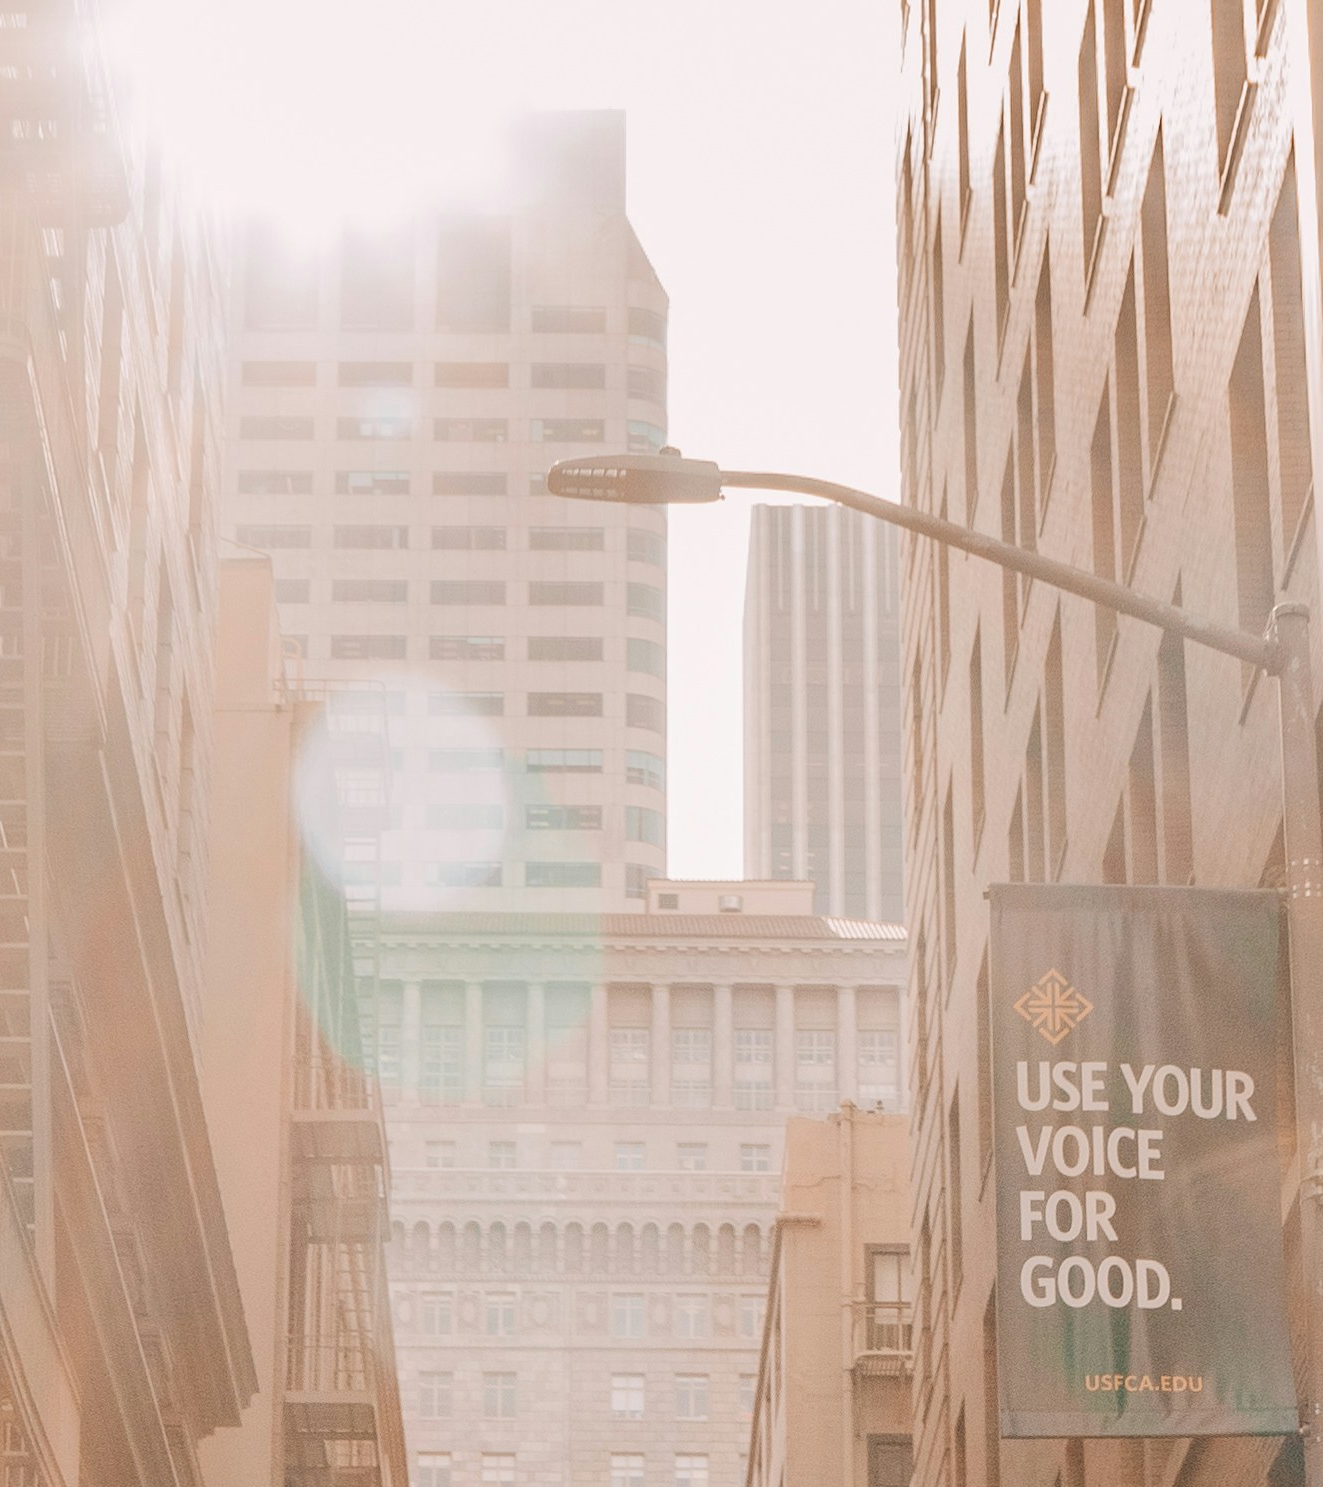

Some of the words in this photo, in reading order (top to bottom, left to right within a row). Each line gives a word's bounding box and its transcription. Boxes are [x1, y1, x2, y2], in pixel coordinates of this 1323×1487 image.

[1016, 1061, 1108, 1112] USE
[1121, 1064, 1257, 1122] YOUR
[1015, 1125, 1166, 1181] VOICE
[1019, 1190, 1118, 1241] FOR
[1020, 1255, 1183, 1311] GOOD.
[1084, 1375, 1204, 1393] USFCA.EDU
